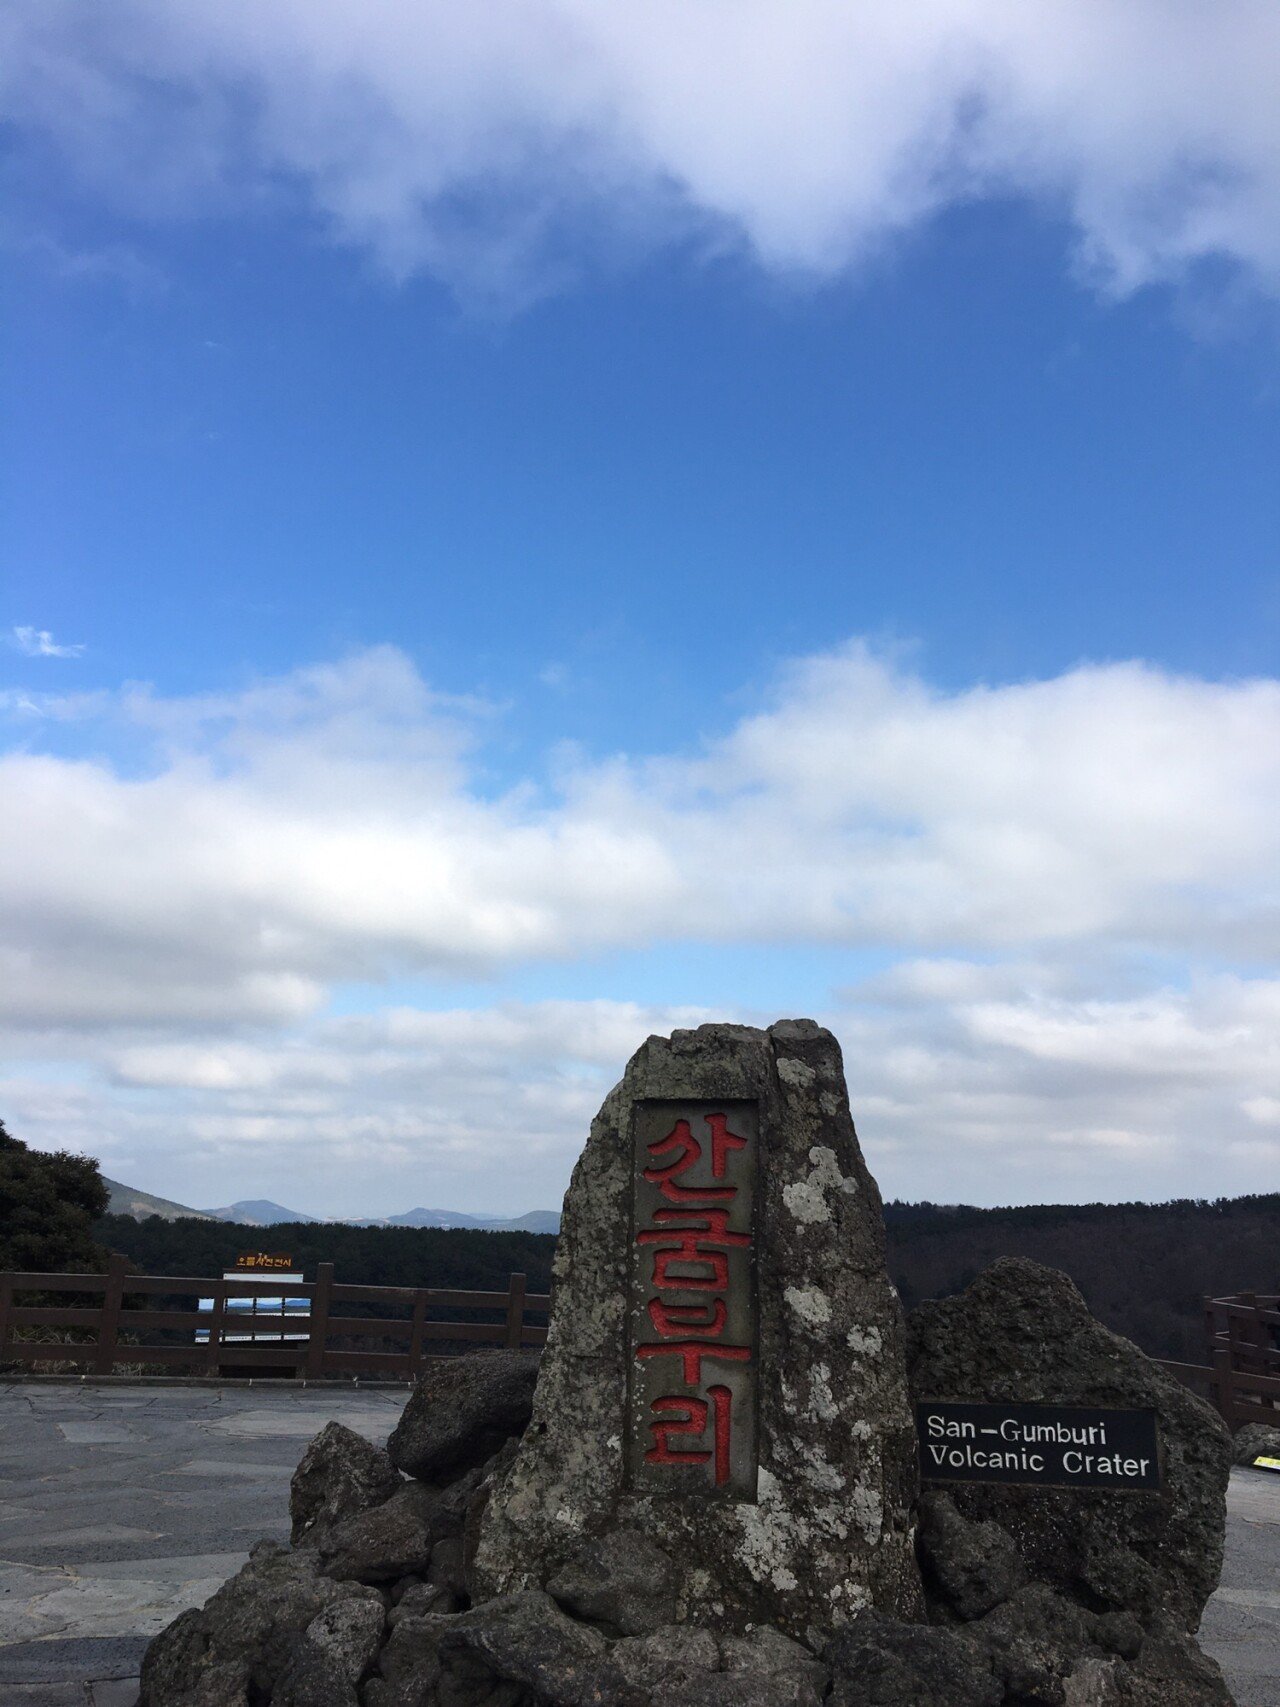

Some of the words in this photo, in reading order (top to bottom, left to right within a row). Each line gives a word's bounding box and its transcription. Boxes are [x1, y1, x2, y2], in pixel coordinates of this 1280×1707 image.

[636, 1113, 752, 1486] 산굼부리
[929, 1445, 1044, 1472] Volcanic
[1063, 1451, 1150, 1477] Crater
